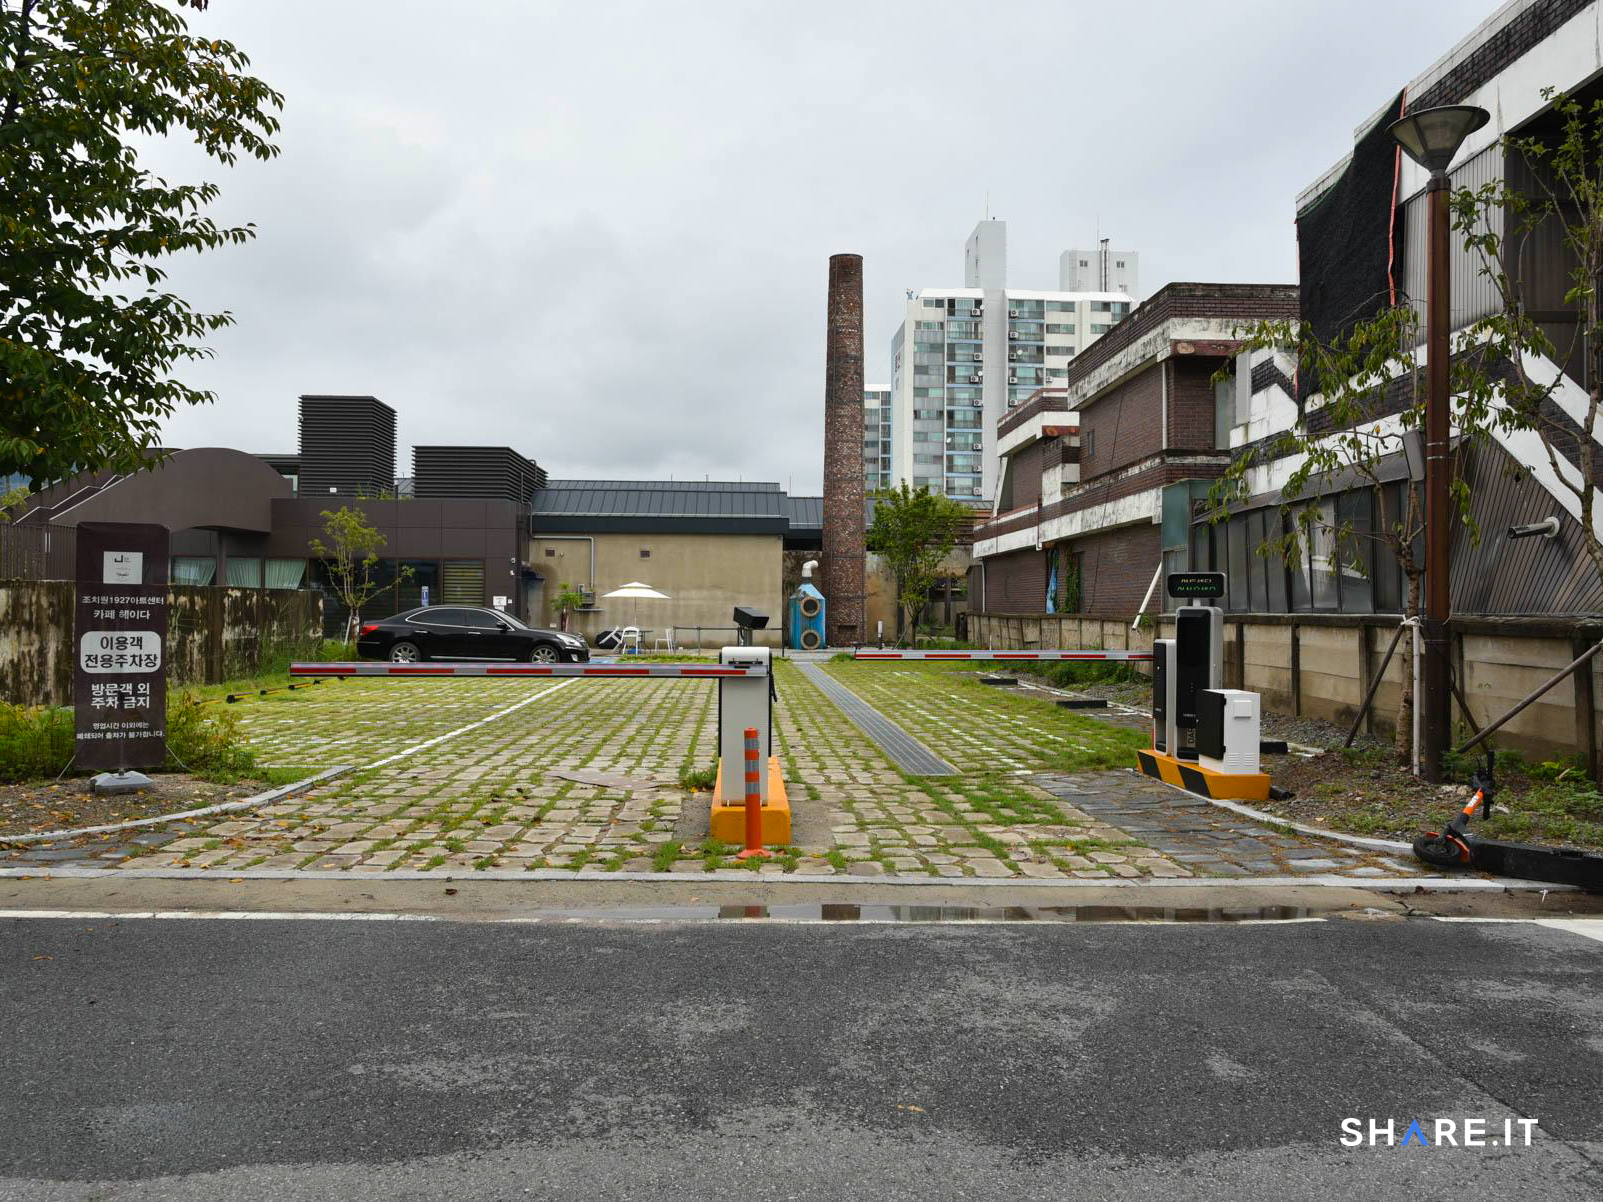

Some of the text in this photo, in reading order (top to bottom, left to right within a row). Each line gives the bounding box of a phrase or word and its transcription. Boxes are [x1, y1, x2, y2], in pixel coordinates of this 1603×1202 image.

[82, 595, 164, 605] 조치원1927아트센터
[93, 609, 151, 619] 카페 헤이다
[100, 636, 143, 650] 이용객
[84, 654, 158, 668] 전용주차장
[91, 682, 150, 696] 방문객 외
[91, 696, 150, 709] 주차 금지
[92, 722, 120, 730] 영업시간
